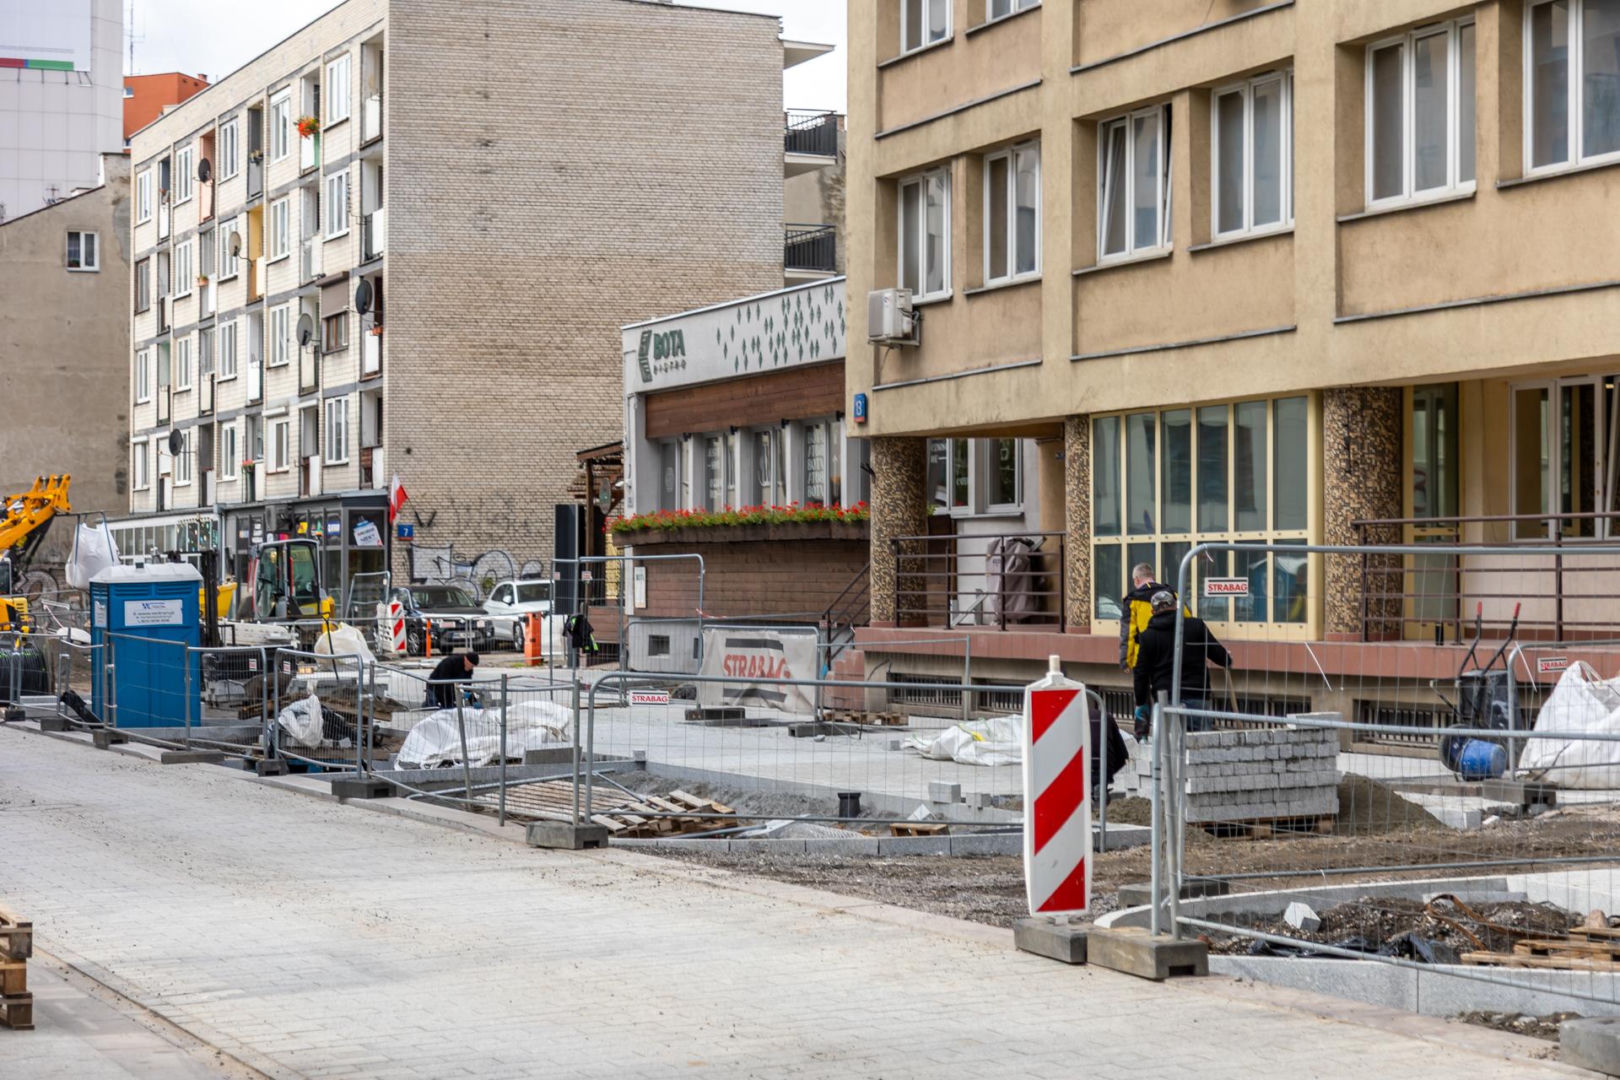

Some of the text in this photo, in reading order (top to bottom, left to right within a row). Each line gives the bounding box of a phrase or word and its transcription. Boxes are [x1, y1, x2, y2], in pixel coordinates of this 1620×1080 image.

[653, 328, 685, 359] BOTA
[403, 527, 409, 537] 7
[1207, 583, 1248, 592] STRABAG
[631, 695, 668, 703] STRABAG
